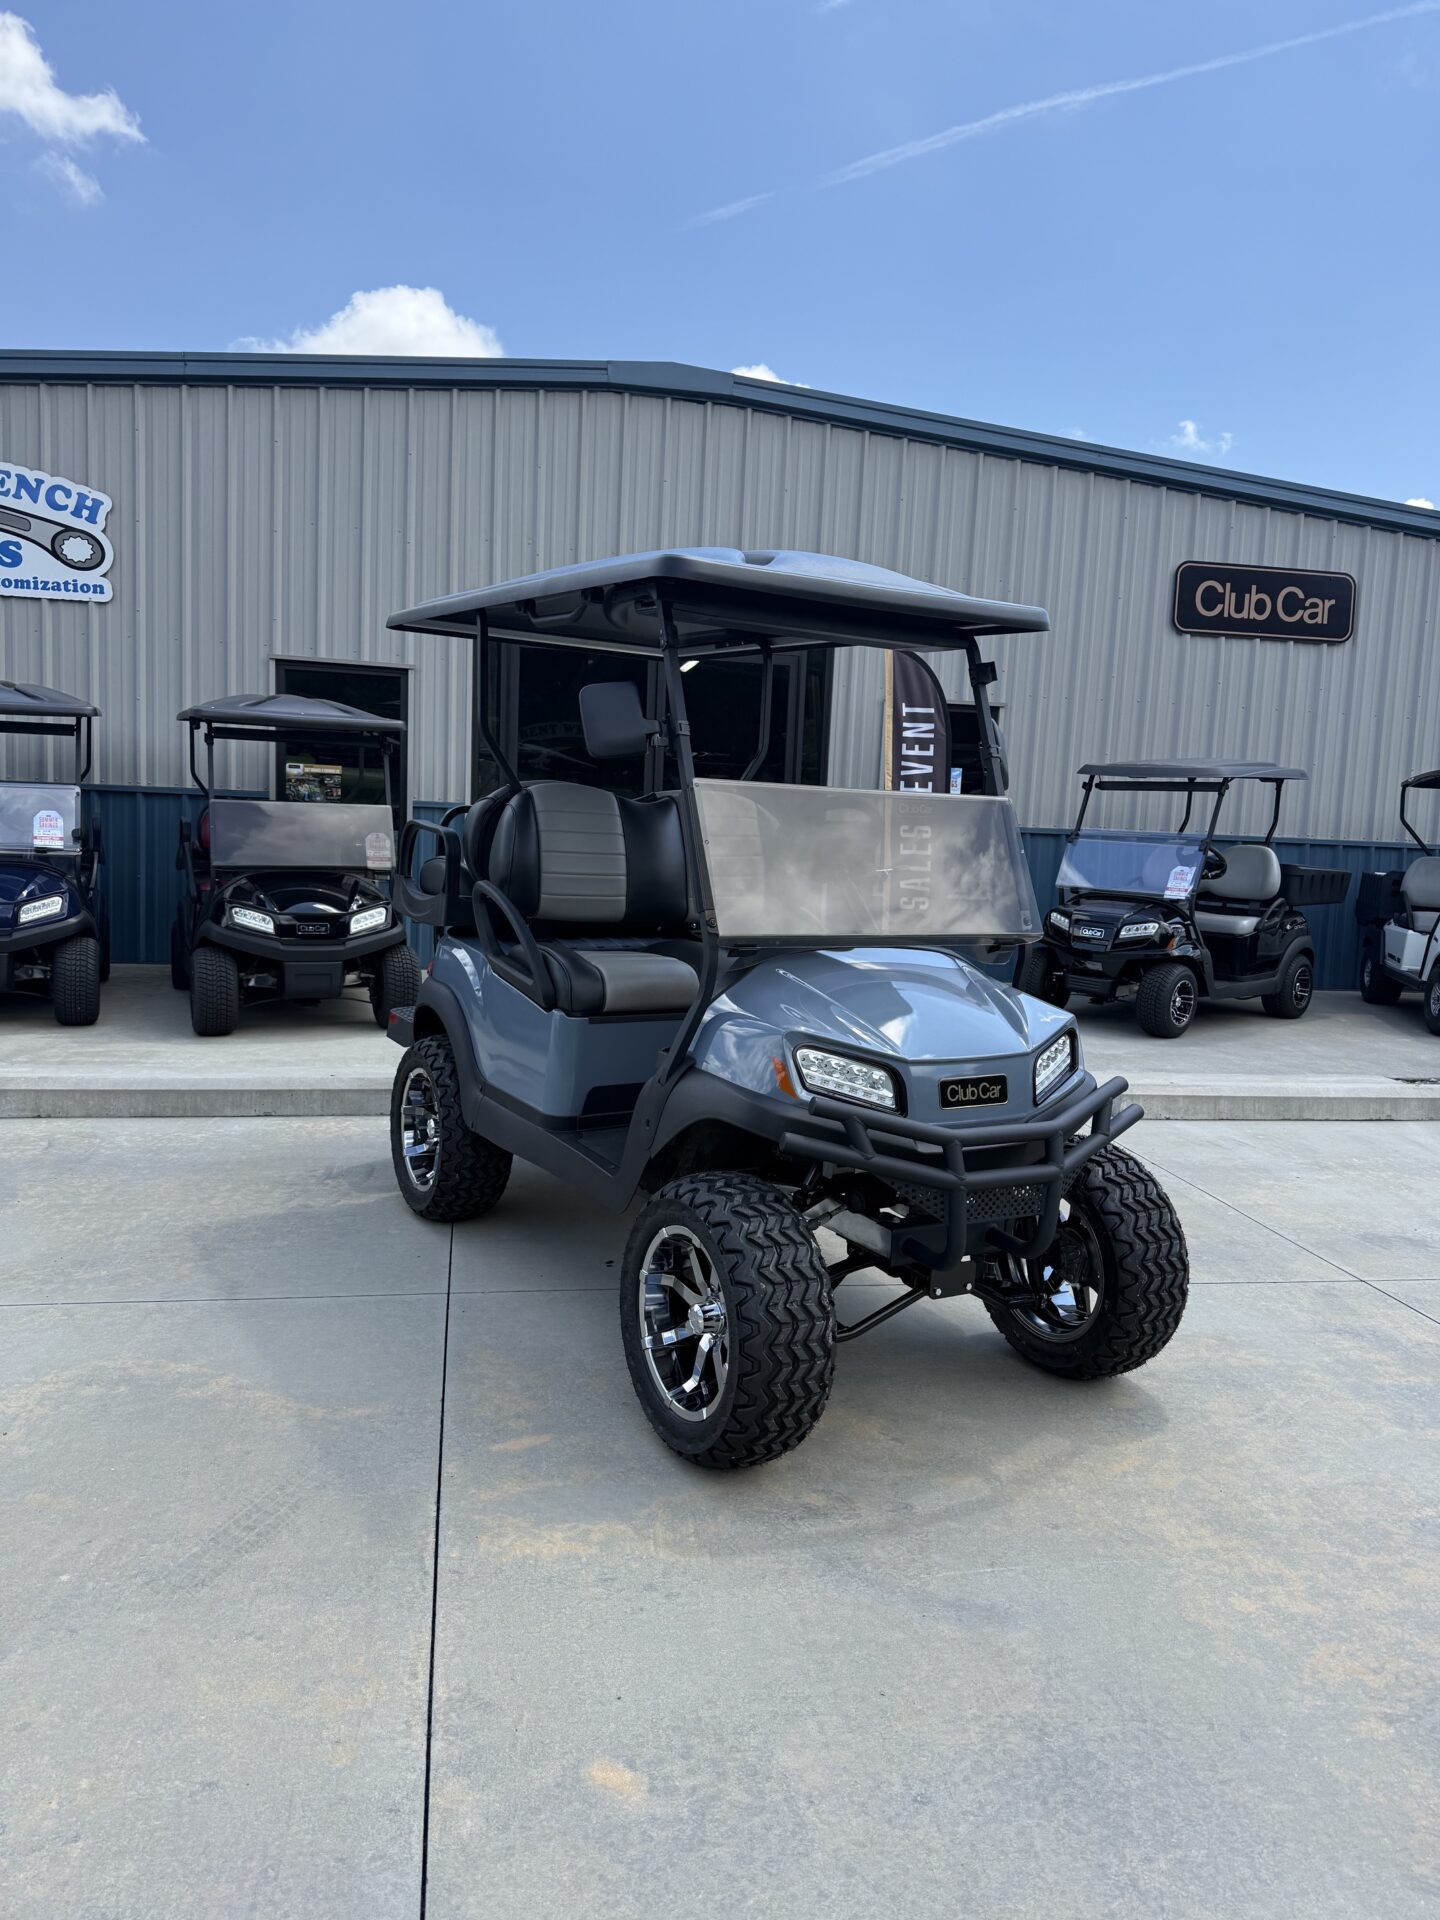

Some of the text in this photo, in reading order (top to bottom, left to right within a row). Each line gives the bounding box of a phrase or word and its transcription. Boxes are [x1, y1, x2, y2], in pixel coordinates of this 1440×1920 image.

[0, 540, 23, 568] S
[1195, 580, 1336, 625] Club Car
[900, 702, 935, 911] SALES EVENT
[946, 1082, 1002, 1102] Club Car
